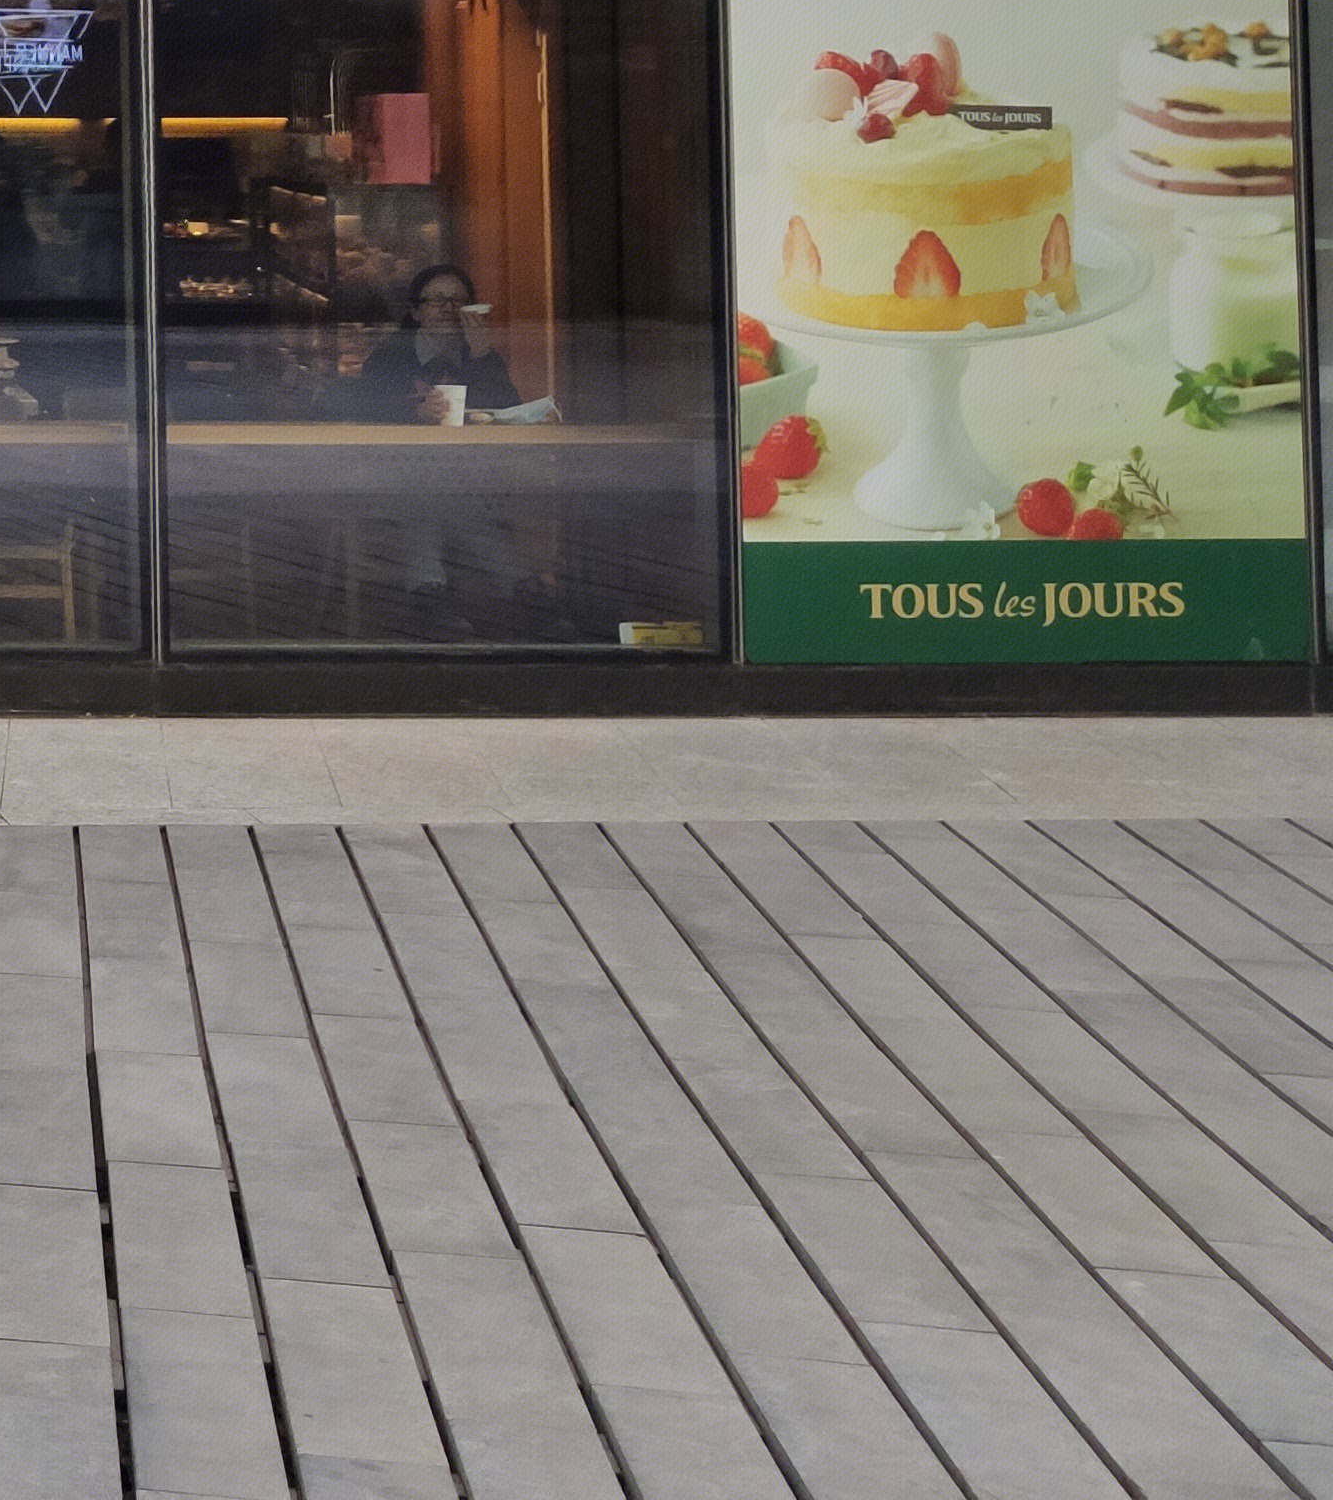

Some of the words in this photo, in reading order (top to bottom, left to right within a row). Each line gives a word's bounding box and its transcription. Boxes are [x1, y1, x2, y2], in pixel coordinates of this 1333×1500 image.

[958, 111, 991, 122] TOUS
[1005, 112, 1042, 124] JOURS
[860, 582, 984, 620] TOUS
[994, 581, 1036, 619] les
[1043, 581, 1185, 626] JOURS
